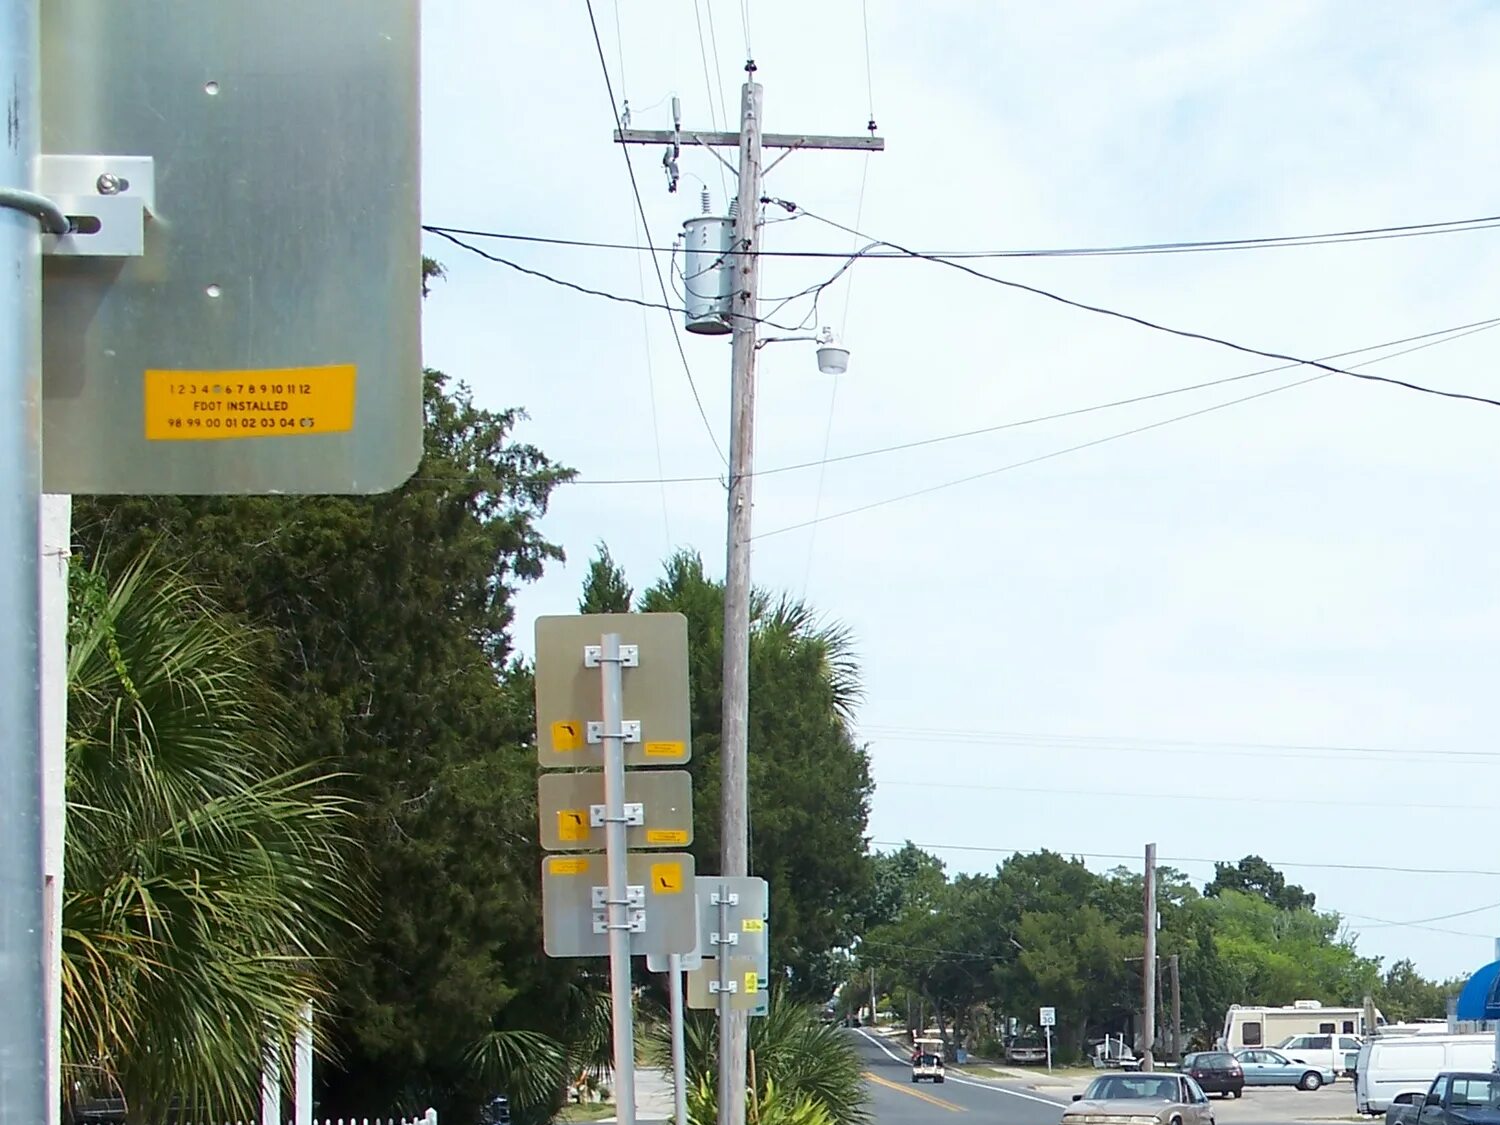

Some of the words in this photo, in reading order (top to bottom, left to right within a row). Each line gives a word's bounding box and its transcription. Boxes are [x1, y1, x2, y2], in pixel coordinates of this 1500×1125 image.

[178, 384, 185, 394] 2
[190, 384, 197, 394] 3
[201, 384, 209, 394] 4
[225, 384, 232, 394] 6
[236, 384, 243, 394] 7
[248, 384, 255, 394] 8
[260, 384, 267, 393] 9
[272, 384, 283, 394] 10
[287, 384, 295, 394] 11
[299, 384, 310, 394] 12
[193, 401, 222, 411] FDOT
[227, 400, 288, 411] INSTALLED
[168, 418, 182, 428] 98
[186, 418, 201, 427] 99
[206, 418, 221, 428] 00
[225, 418, 237, 428] 01
[241, 418, 256, 428] 02
[261, 418, 275, 427] 03
[280, 418, 295, 427] 04
